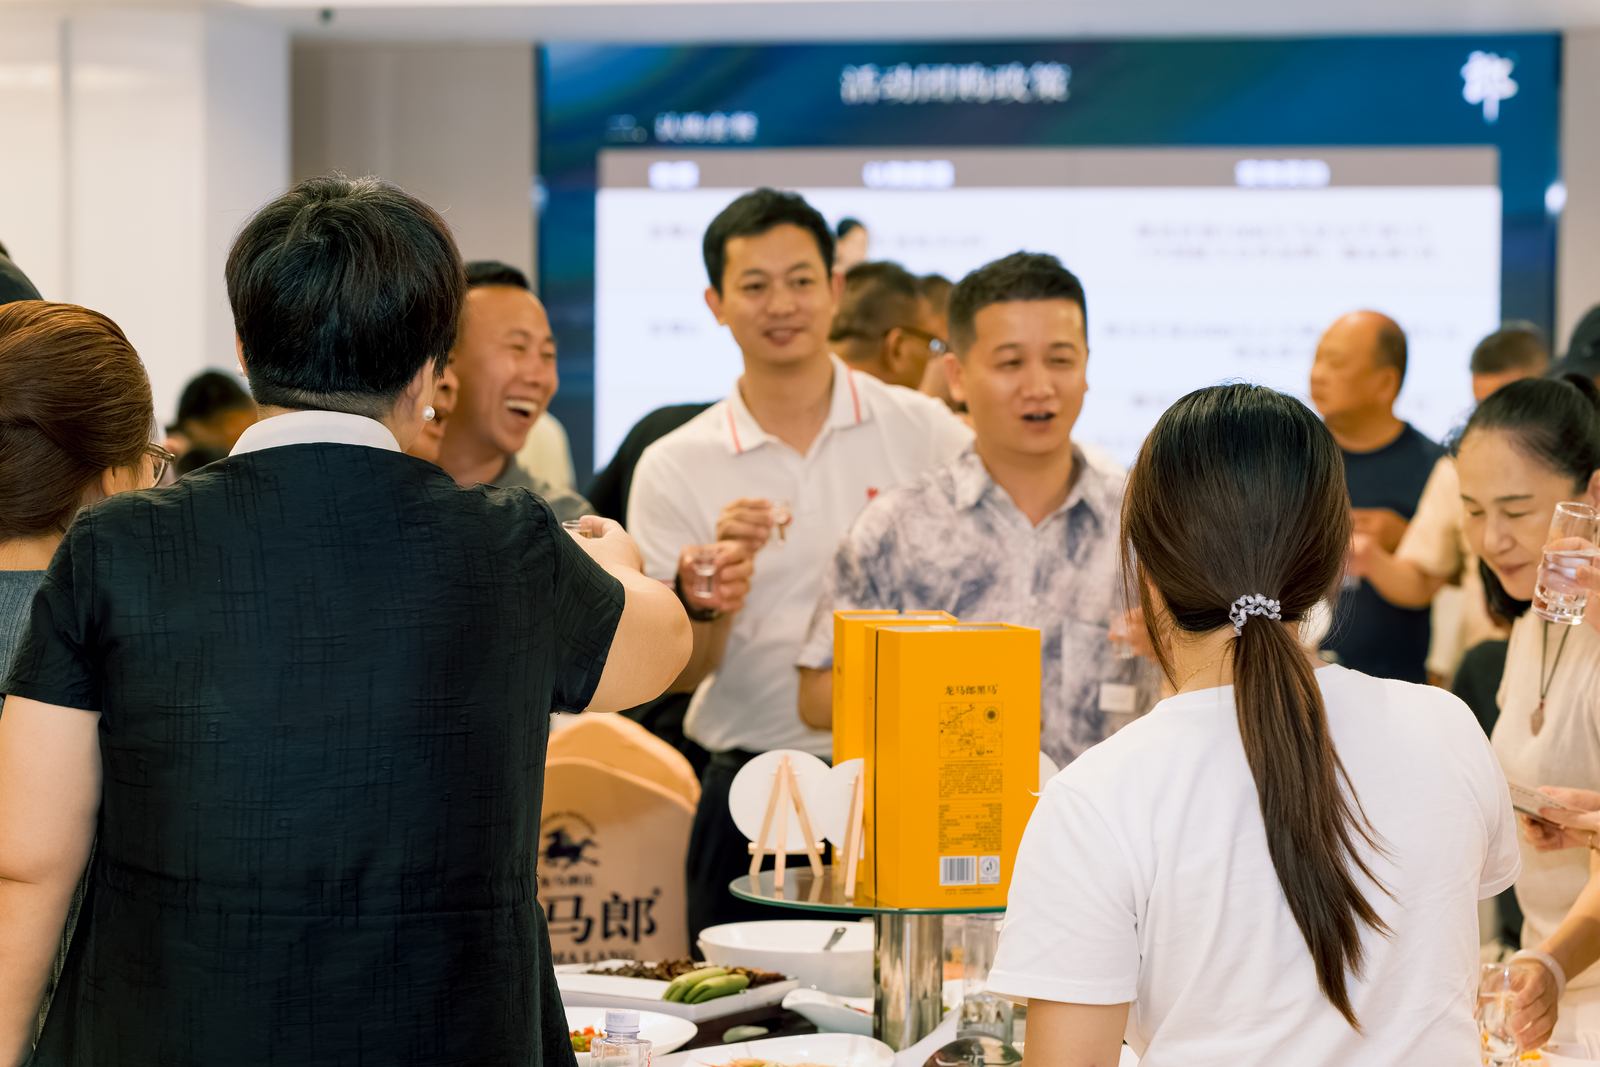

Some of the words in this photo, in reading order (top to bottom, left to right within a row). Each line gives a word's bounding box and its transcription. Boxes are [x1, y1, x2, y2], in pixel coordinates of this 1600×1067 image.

[842, 63, 1070, 103] 活动团购政策
